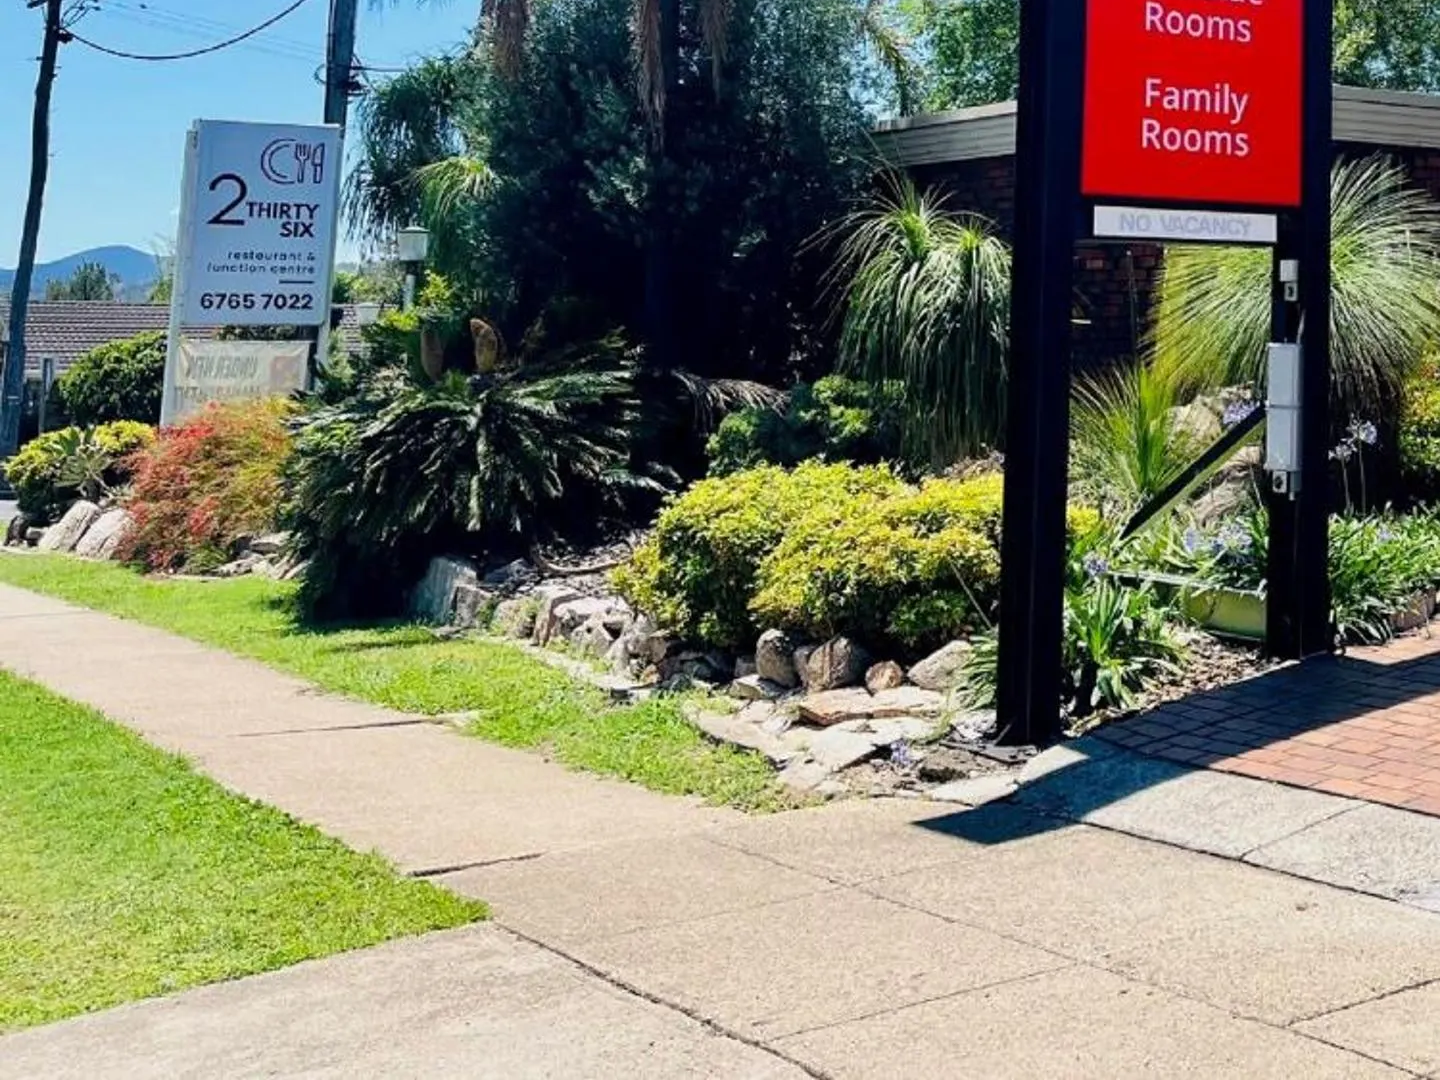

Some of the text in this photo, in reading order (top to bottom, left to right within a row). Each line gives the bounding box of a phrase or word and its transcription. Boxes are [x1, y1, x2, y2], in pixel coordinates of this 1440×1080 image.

[1145, 1, 1252, 43] Rooms
[1144, 77, 1249, 125] Family
[1142, 118, 1250, 157] Rooms
[246, 201, 321, 220] THIRTY
[279, 221, 315, 238] SIX
[1119, 211, 1251, 237] NO VACANCY
[228, 250, 302, 262] restaurant
[207, 262, 316, 275] function centre
[200, 293, 315, 310] 6765 7022
